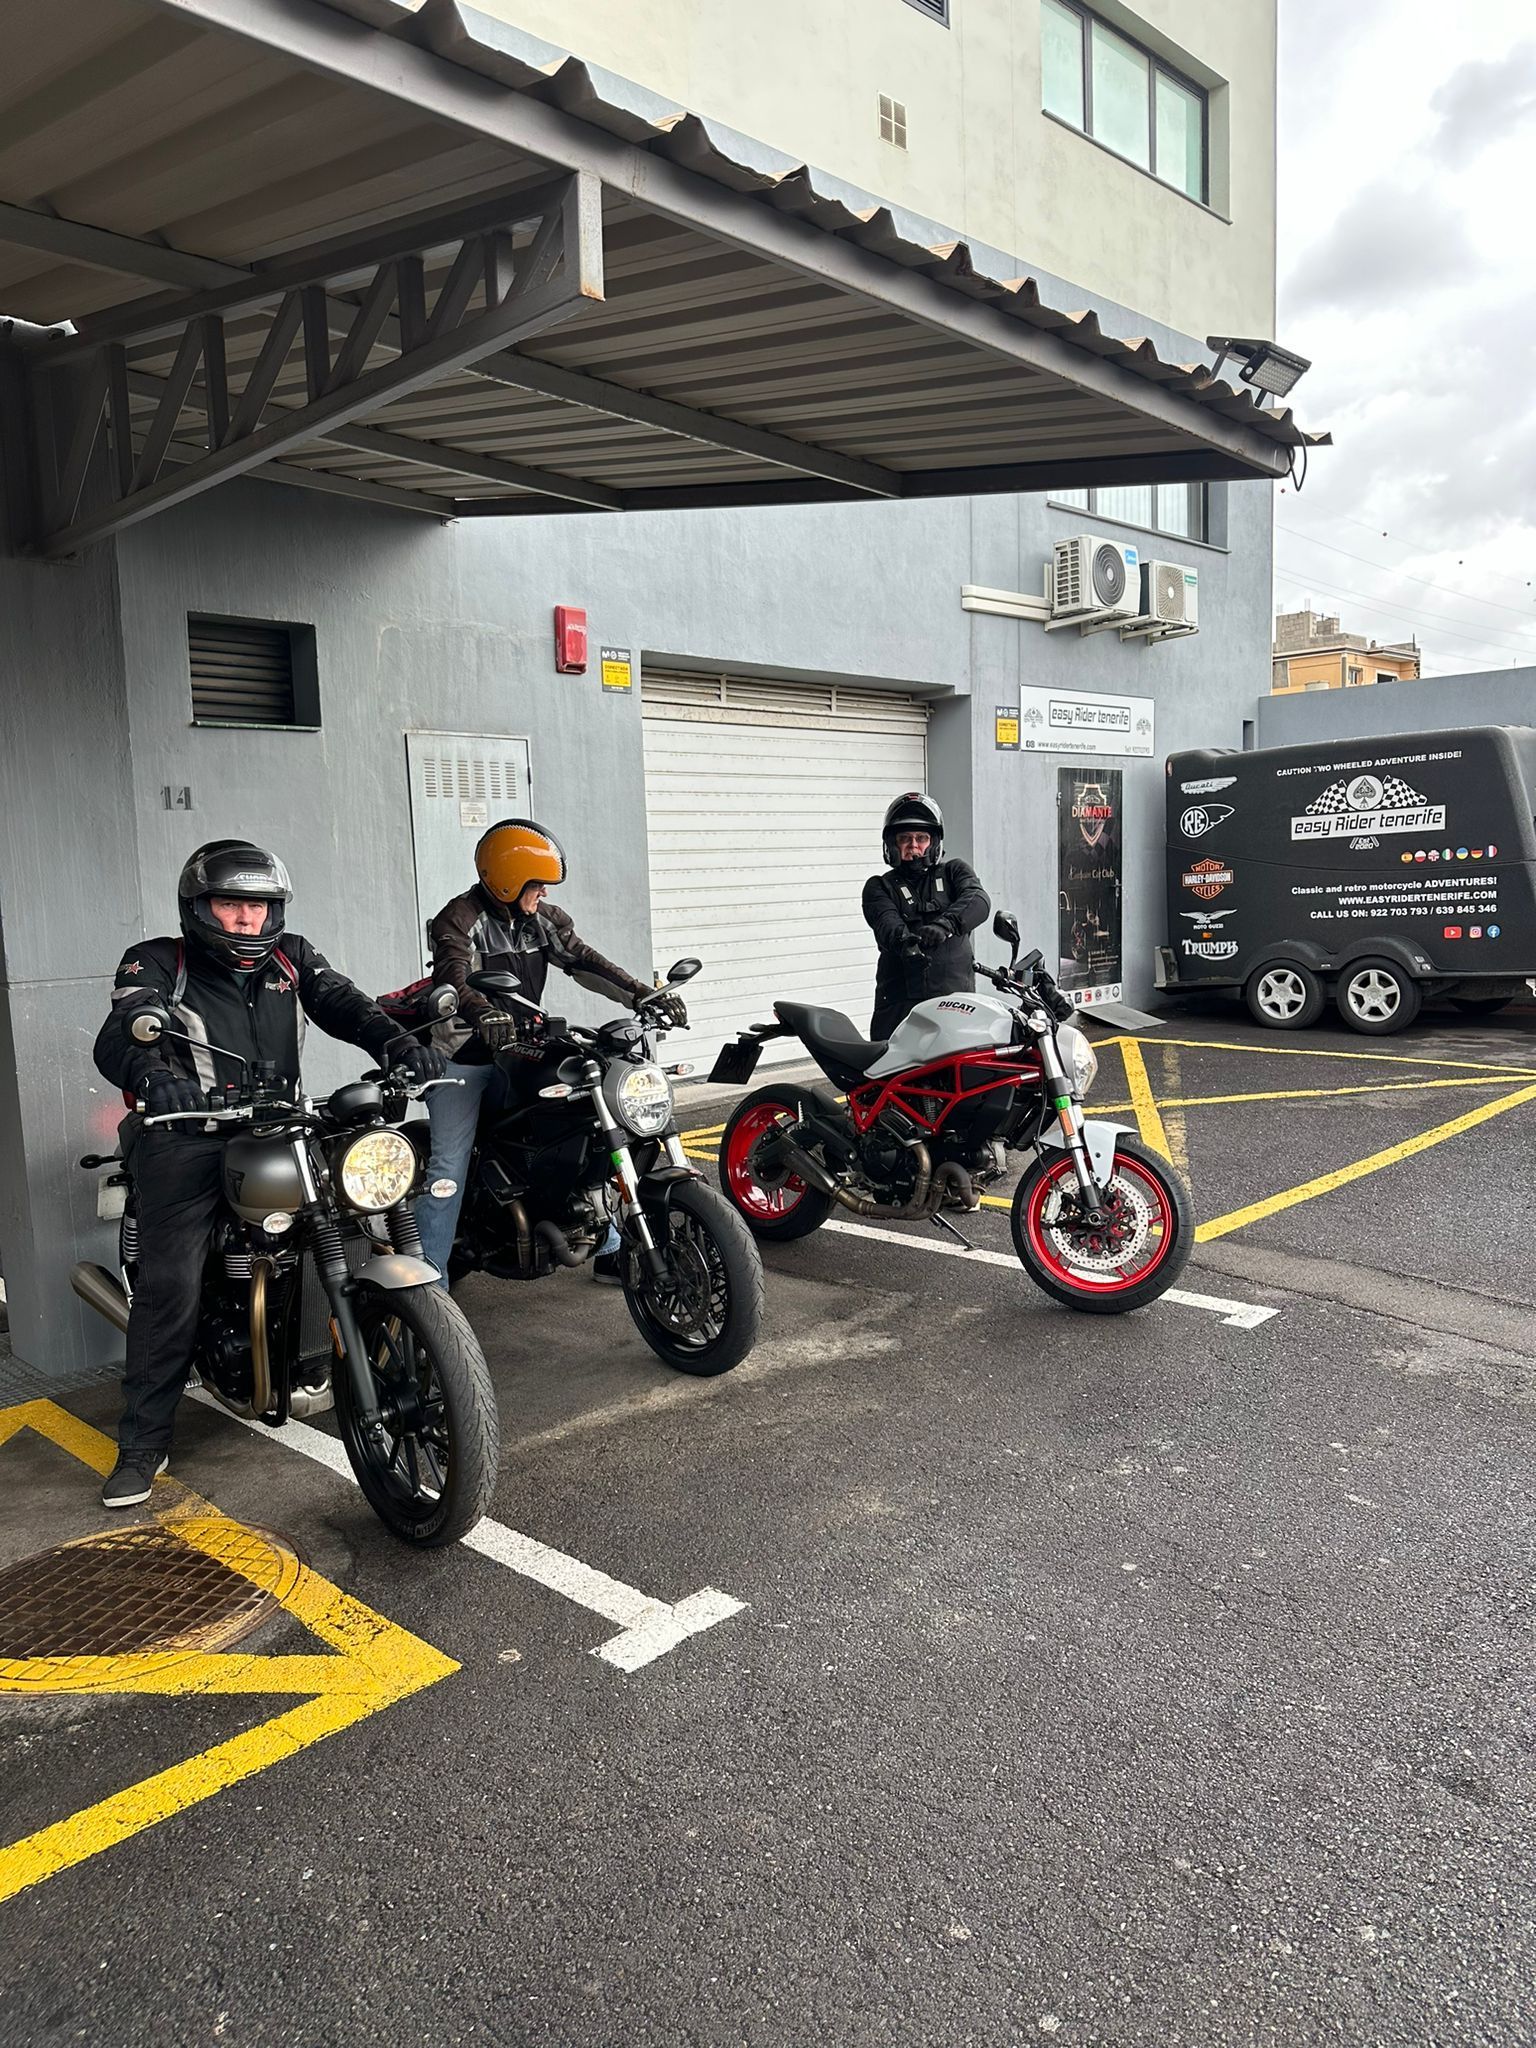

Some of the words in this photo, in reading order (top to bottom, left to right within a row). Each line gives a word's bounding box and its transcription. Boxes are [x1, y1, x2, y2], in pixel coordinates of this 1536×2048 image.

[1052, 708, 1074, 725] easy
[1075, 707, 1097, 723] Rider
[1098, 709, 1129, 726] tenerife
[1276, 766, 1312, 776] CAUTION
[1313, 765, 1331, 774] TWO
[1333, 760, 1373, 771] WHEELED
[1374, 754, 1427, 767] ADVENTURE
[1428, 750, 1462, 761] INSIDE!
[160, 786, 192, 811] 14
[1071, 805, 1112, 818] DIAMANTE
[1294, 819, 1332, 836] easy
[1335, 815, 1376, 832] Rider
[1379, 808, 1443, 828] tenerife
[1195, 861, 1220, 872] MOTOR
[1184, 872, 1231, 885] HARLEY-DAVIDSON
[1291, 885, 1324, 895] Classic
[1325, 884, 1343, 893] and
[1344, 883, 1368, 892] retro
[1369, 880, 1423, 892] motorcycle
[1424, 876, 1498, 889] ADVENTURES!
[1195, 884, 1221, 897] CYCLES
[1338, 890, 1498, 905] WWW.EASYRIDERTENERIFE.COM
[1310, 911, 1334, 919] CALL
[1336, 910, 1349, 918] US
[1351, 909, 1369, 918] ON:
[1370, 908, 1388, 917] 922
[1390, 907, 1408, 916] 703
[1410, 907, 1428, 915] 793
[1435, 905, 1454, 915] 639
[1456, 904, 1476, 914] 845
[1478, 904, 1498, 913] 346
[1181, 938, 1239, 960] TRIUMPH
[938, 1001, 976, 1013] DUCATI
